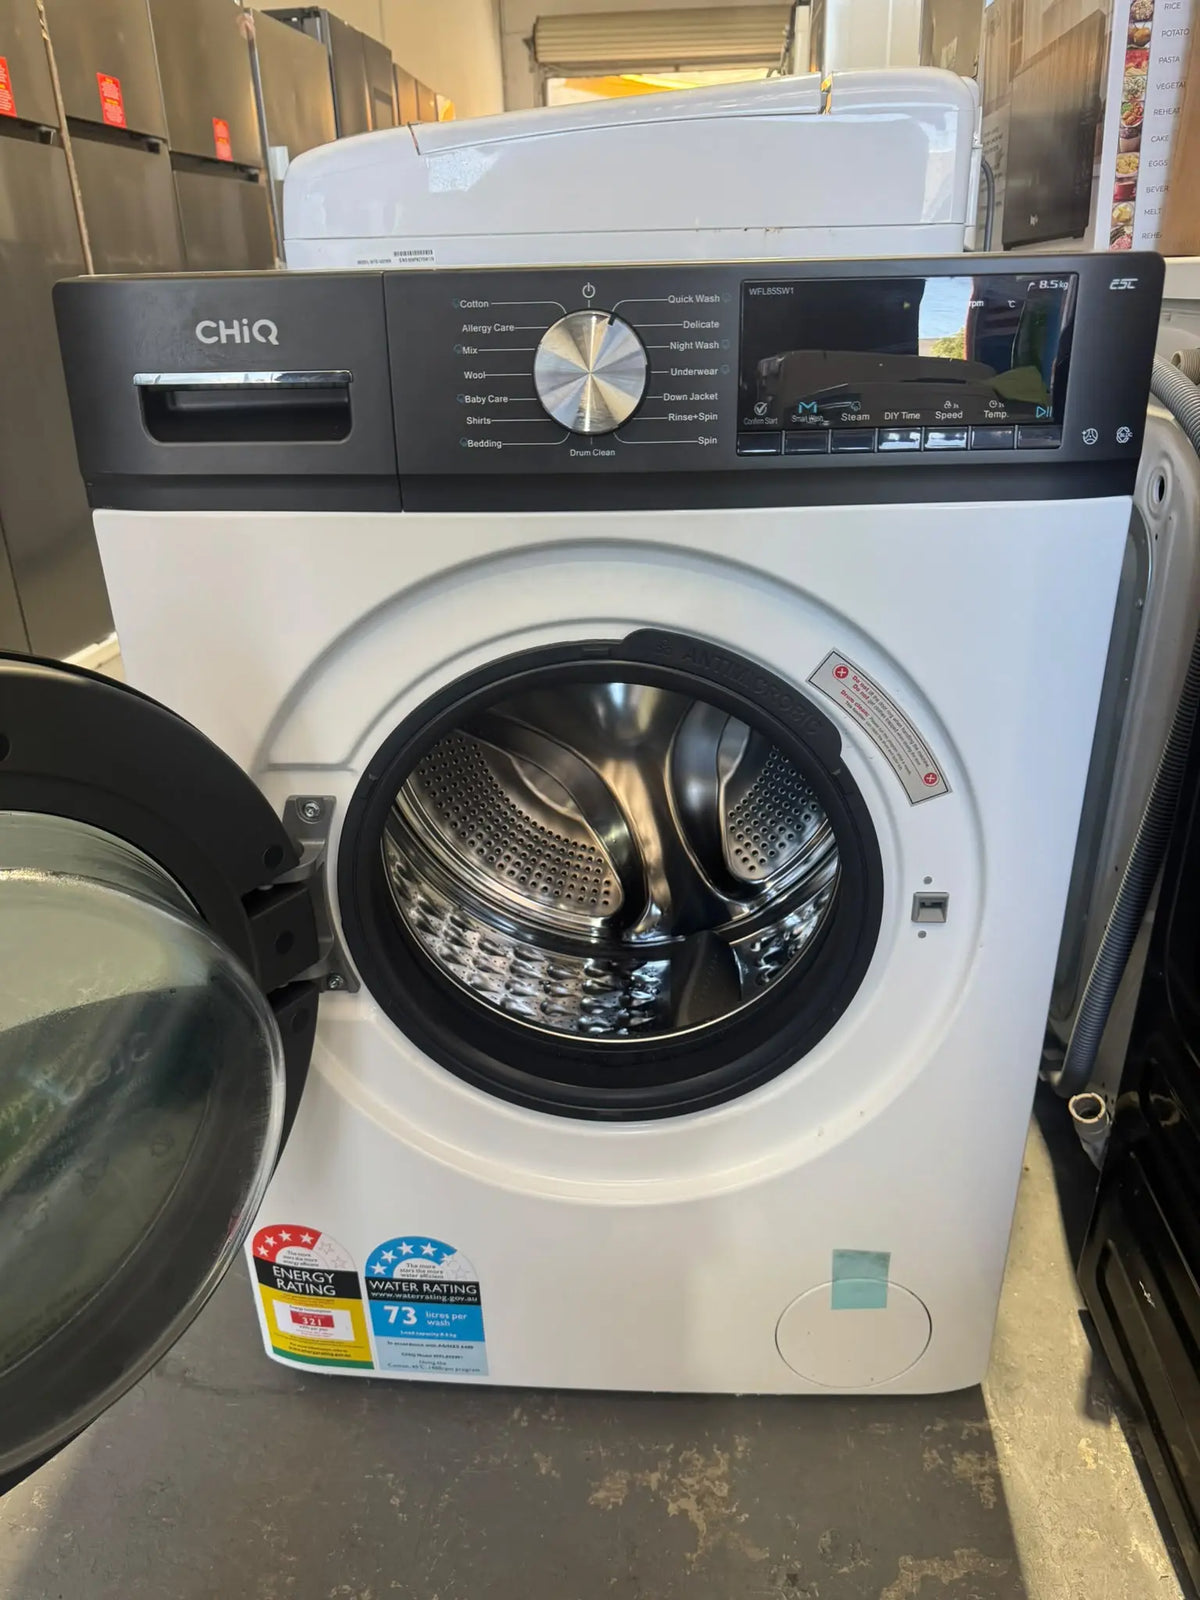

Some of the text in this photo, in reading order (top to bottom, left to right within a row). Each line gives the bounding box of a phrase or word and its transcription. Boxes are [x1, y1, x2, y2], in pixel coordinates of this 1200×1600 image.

[1161, 28, 1190, 37] POTATO
[1158, 56, 1180, 64] PASTA
[1150, 135, 1169, 143] CAKE
[1148, 160, 1168, 168] EGGS
[459, 299, 489, 309] Cotton
[667, 294, 721, 304] Quick Wash
[462, 323, 515, 334] Allergy Care
[683, 320, 720, 329] Delicate
[195, 318, 280, 345] CHiQ
[462, 346, 478, 355] Mix
[669, 341, 720, 351] Night Wash
[464, 371, 486, 380] Wool
[670, 368, 719, 376] Underwear
[464, 395, 509, 405] Baby Care
[663, 392, 718, 401] Down Jacket
[466, 416, 492, 425] Shirts
[668, 414, 718, 424] Rinse+Spin
[840, 413, 870, 422] Steam
[884, 411, 921, 420] DIY Time
[935, 411, 963, 421] Speed
[764, 417, 778, 425] Start
[467, 439, 503, 449] Bedding
[697, 438, 718, 448] Spin
[570, 449, 616, 457] Drum Clean
[272, 1265, 335, 1284] ENERGY
[276, 1278, 337, 1296] RATING
[369, 1280, 477, 1295] WATER RATING
[371, 1291, 478, 1303] www.waterrating.gov.au
[383, 1305, 418, 1325] 73
[425, 1310, 468, 1321] litres per
[302, 1316, 322, 1326] 321
[426, 1318, 451, 1327] wash
